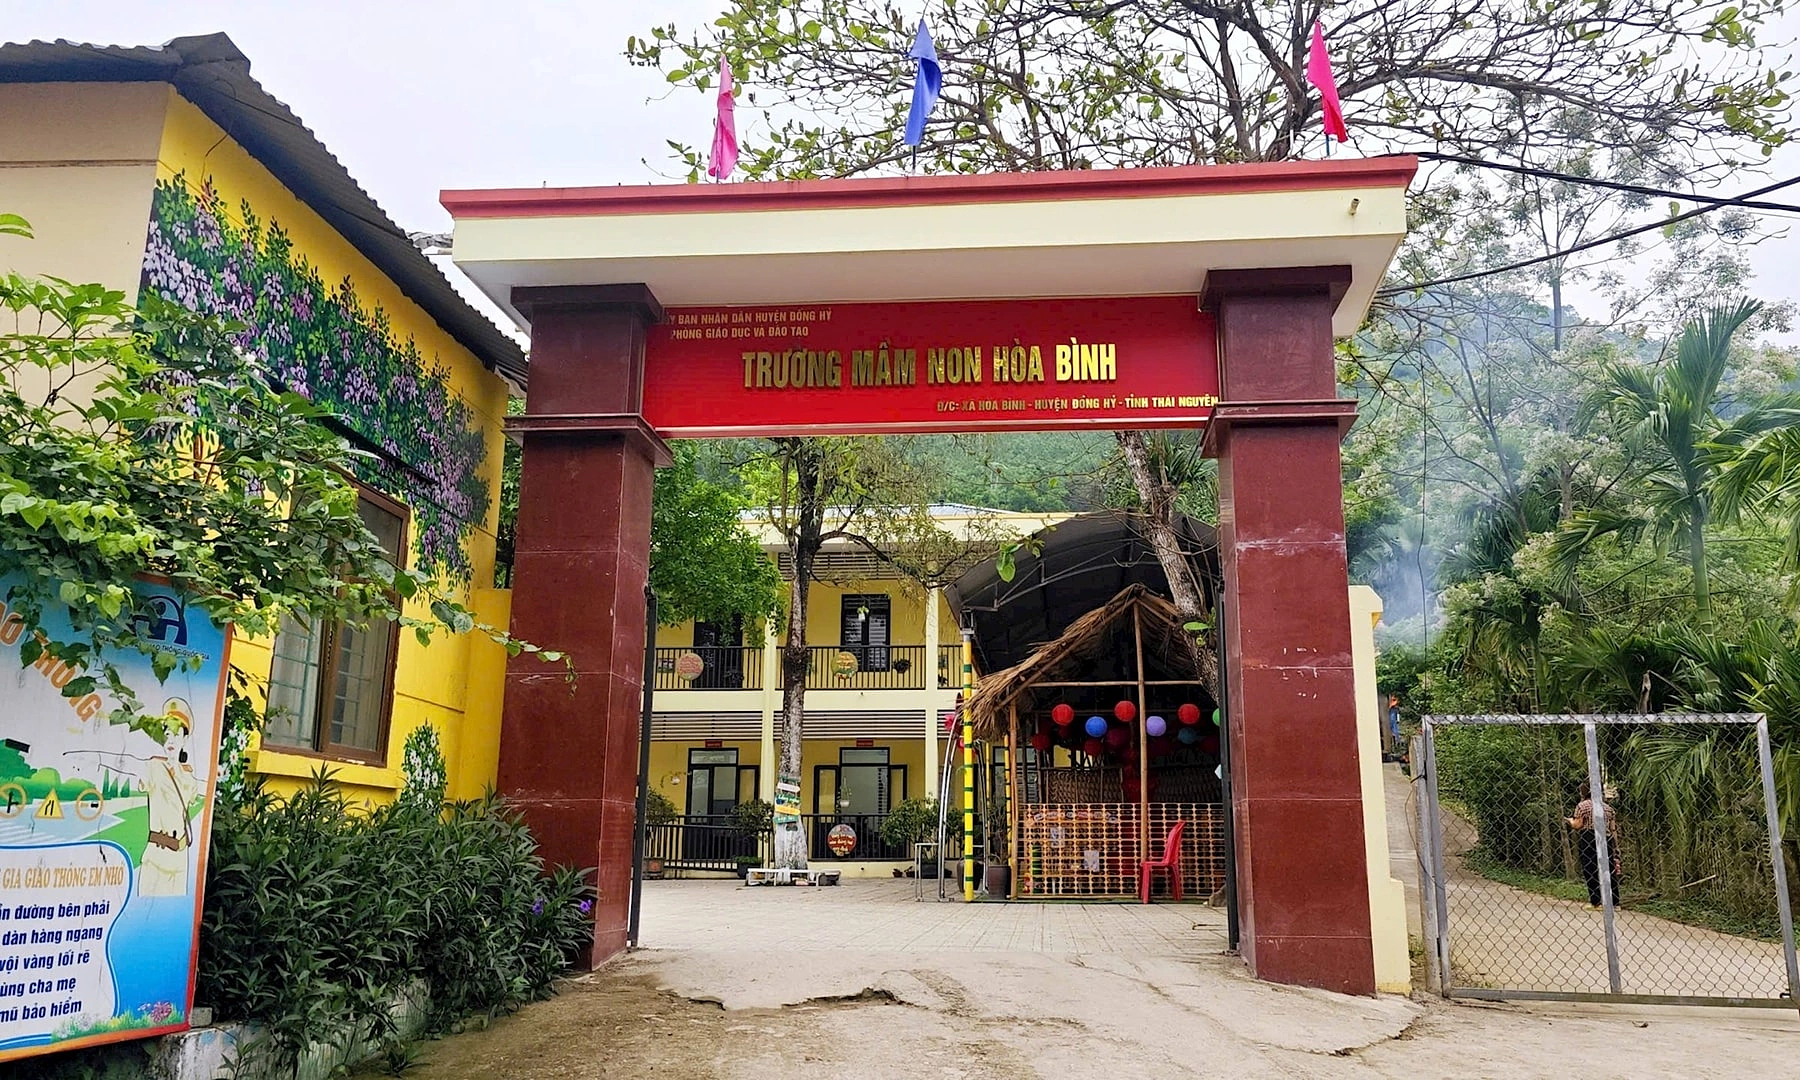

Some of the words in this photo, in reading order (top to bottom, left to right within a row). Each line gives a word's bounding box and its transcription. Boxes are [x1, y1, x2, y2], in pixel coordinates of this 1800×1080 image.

[678, 314, 698, 325] BAN
[755, 309, 787, 325] HUYỆN
[705, 325, 728, 338] GIÁO
[753, 324, 765, 337] VÀ
[742, 345, 843, 389] TRƯỜNG
[851, 338, 917, 387] MẦM
[927, 346, 982, 384] NON
[992, 338, 1045, 383] HÒA
[1055, 337, 1117, 382] BÌNH
[1034, 396, 1068, 412] HUYỆN
[1125, 393, 1149, 408] TỈNH
[1178, 393, 1219, 407] NGUYÊN
[2, 867, 21, 889] GIA
[87, 866, 104, 888] EM
[15, 903, 54, 921] đường
[58, 902, 81, 919] bên
[83, 899, 110, 918] phải
[2, 930, 27, 946] dàn
[31, 929, 62, 945] hàng
[65, 926, 103, 942] ngang
[0, 956, 19, 975] vội
[23, 954, 54, 970] vàng
[57, 949, 74, 967] lối
[77, 949, 90, 964] rẽ
[29, 979, 52, 994] cha
[56, 977, 77, 992] mẹ
[22, 1002, 46, 1020] bảo
[50, 996, 82, 1016] hiểm
